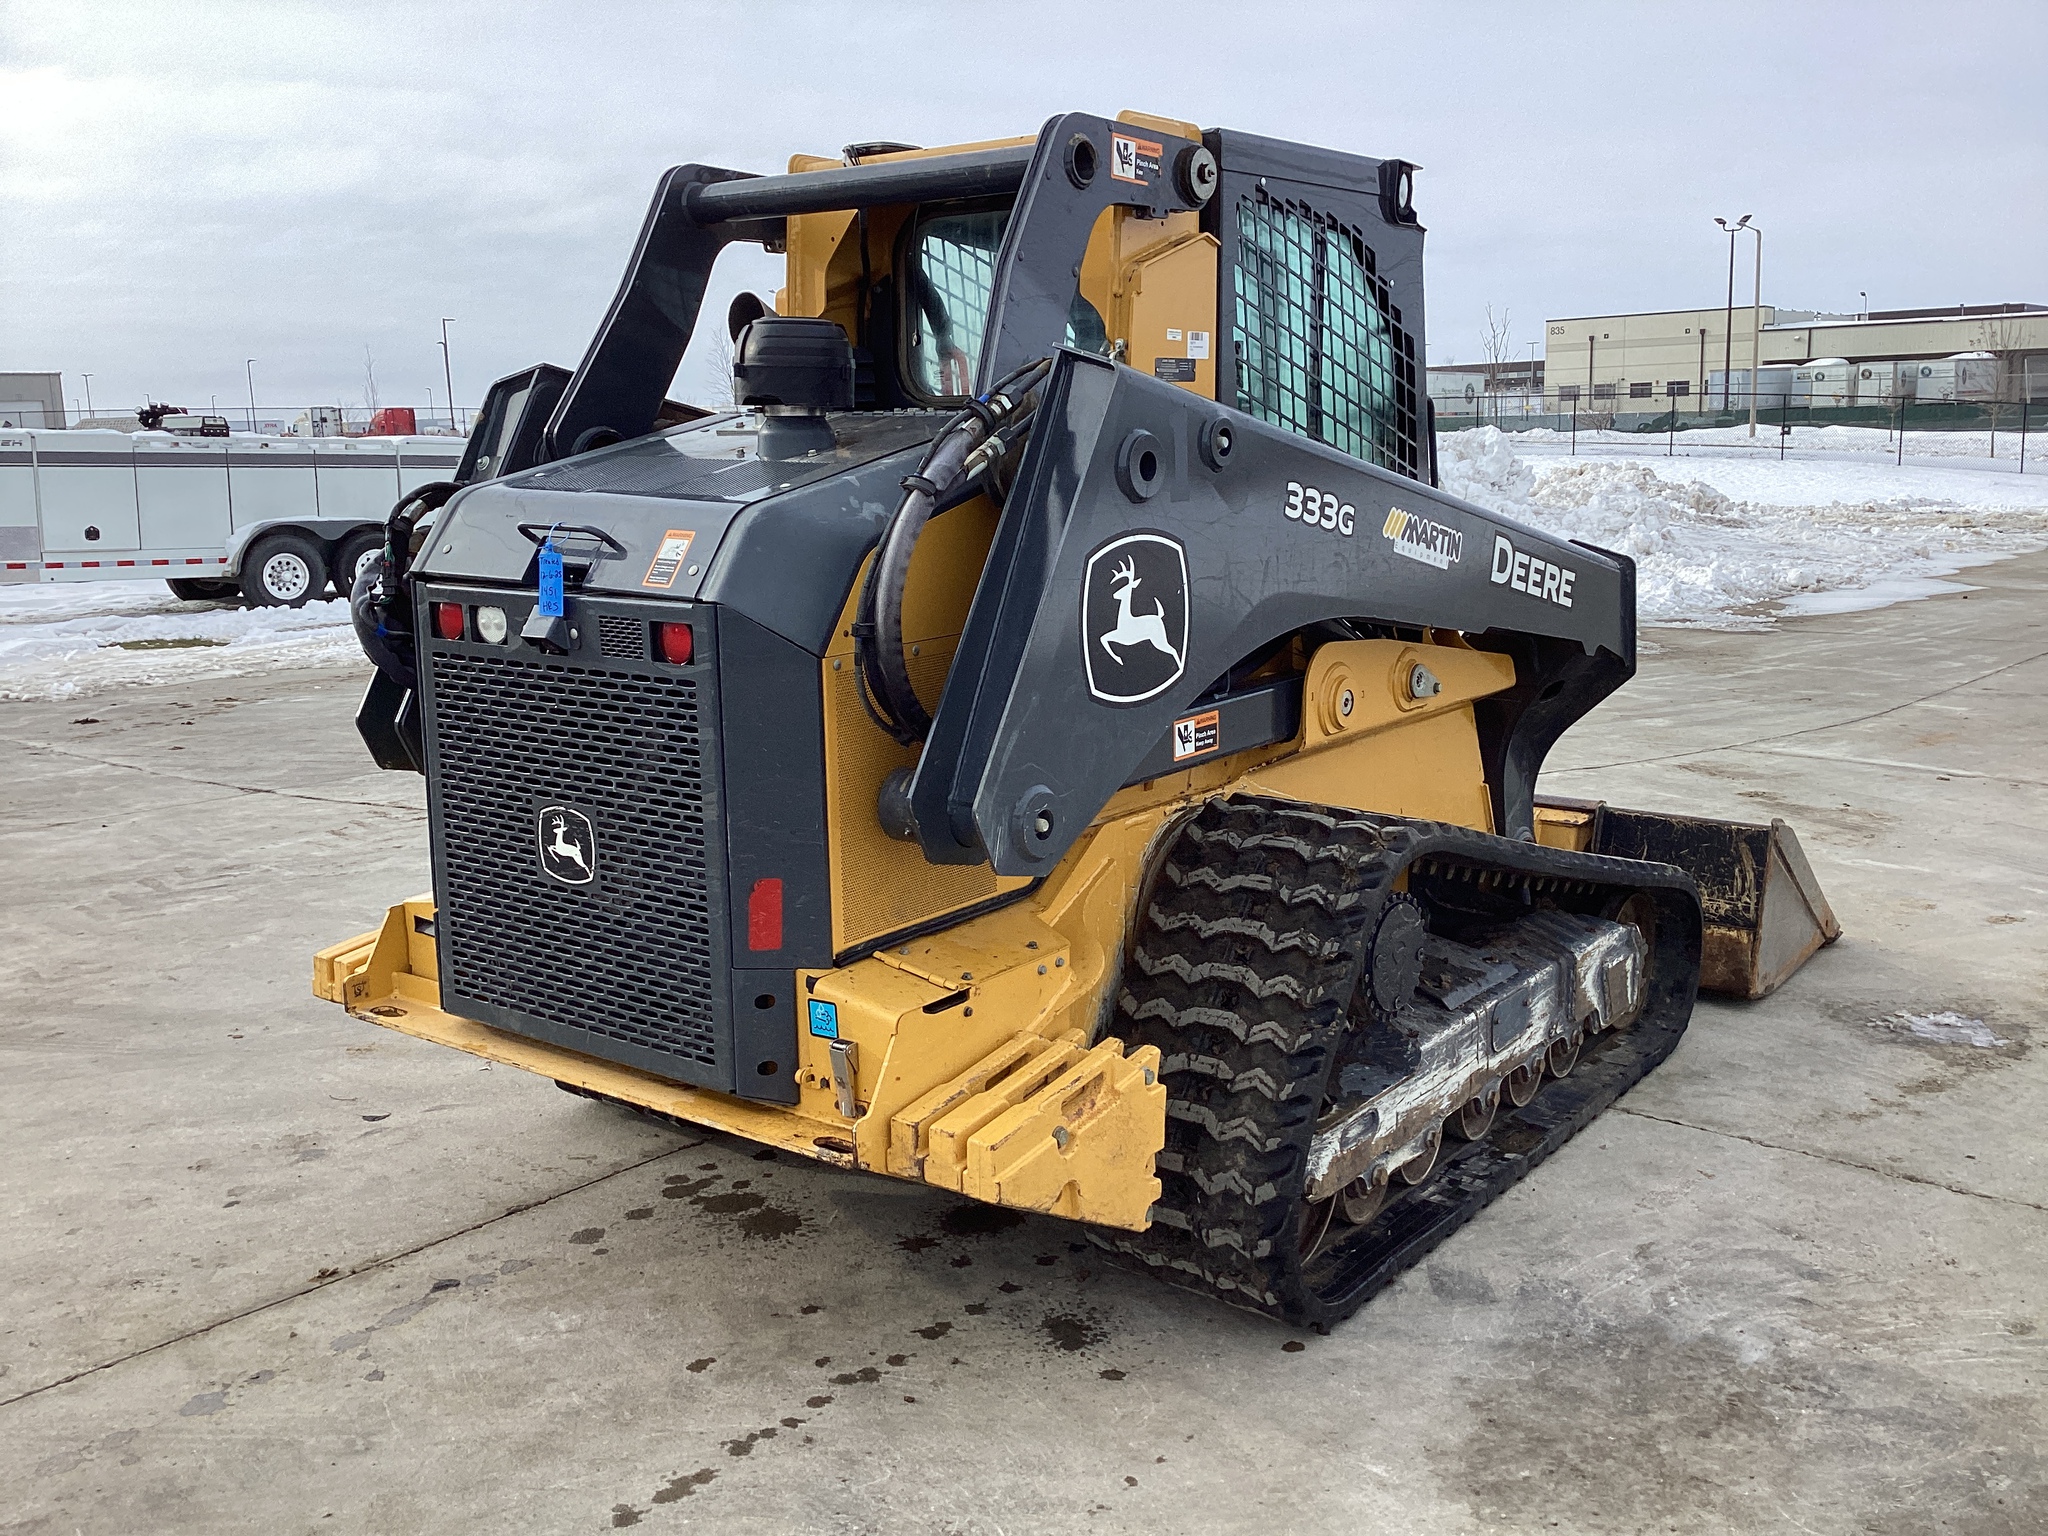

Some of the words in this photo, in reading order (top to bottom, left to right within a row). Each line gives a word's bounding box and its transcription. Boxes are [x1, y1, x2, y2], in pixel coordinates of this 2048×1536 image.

[1136, 158, 1148, 168] Pinch
[1550, 326, 1565, 336] 835
[1284, 481, 1356, 536] 333G
[1400, 514, 1463, 563] MARTIN
[1490, 535, 1576, 607] DEERE
[541, 586, 557, 599] 1451
[542, 600, 560, 613] HRS
[1196, 731, 1207, 739] Pinch
